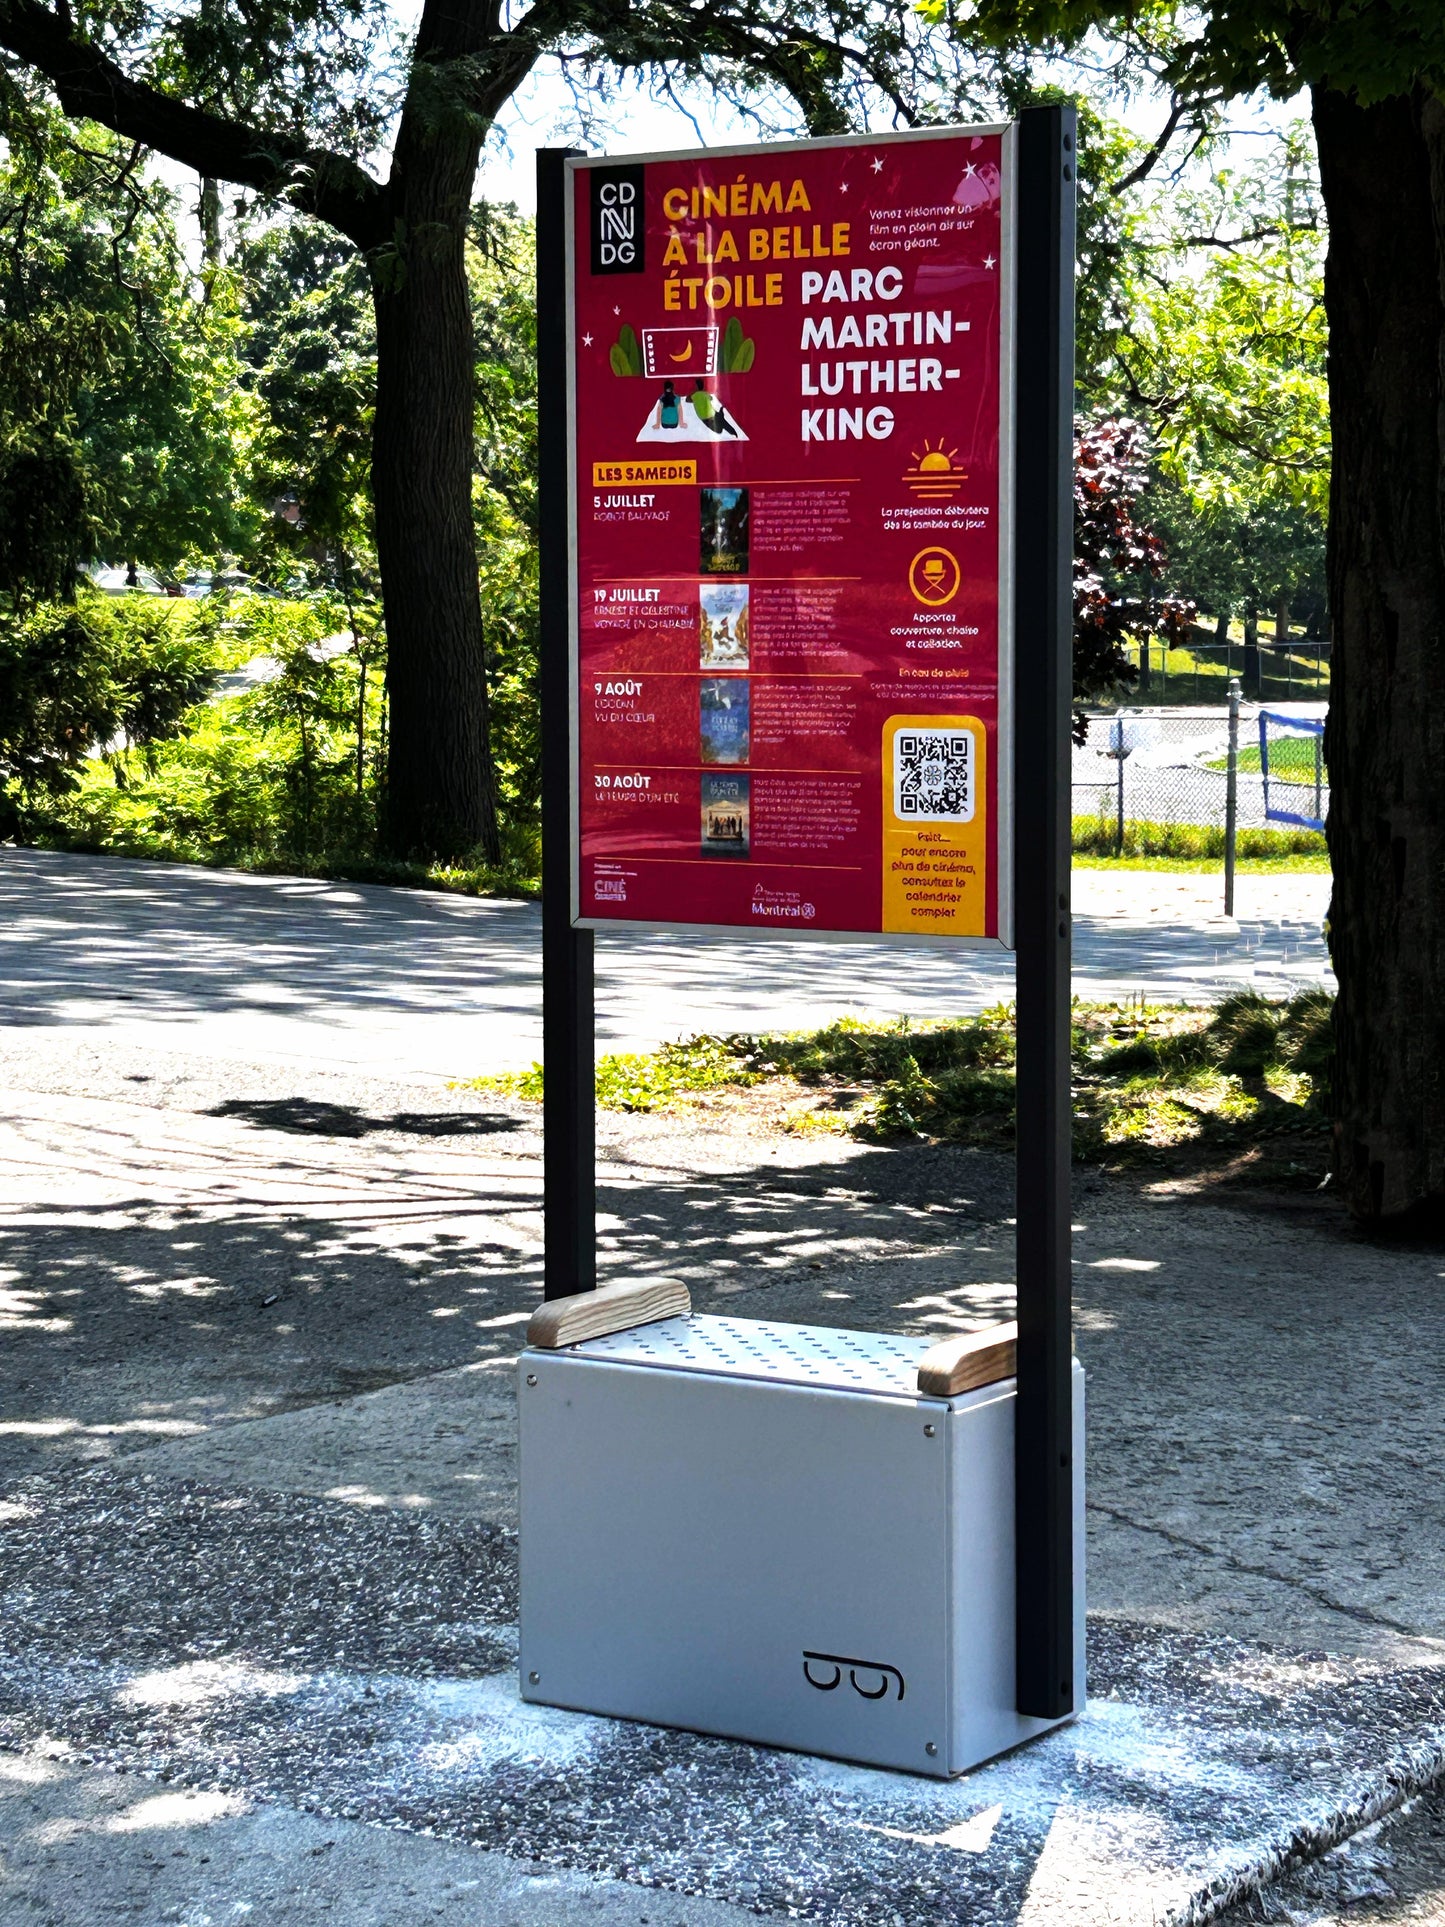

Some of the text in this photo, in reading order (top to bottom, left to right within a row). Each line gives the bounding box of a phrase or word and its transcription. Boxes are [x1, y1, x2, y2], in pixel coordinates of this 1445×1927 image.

[600, 182, 636, 206] CD
[663, 174, 811, 221] CINÉMA
[956, 219, 975, 230] sur
[600, 241, 636, 265] DG
[662, 222, 851, 266] À LA BELLE
[664, 269, 783, 311] ÉTOILE
[801, 265, 904, 305] PARC
[800, 310, 971, 350] MARTIN-
[801, 358, 961, 396] LUTHER-
[801, 405, 895, 442] KING
[598, 466, 692, 482] LES SAMEDIS
[593, 494, 656, 508] 5 JUILLET
[881, 507, 893, 517] La
[902, 519, 912, 529] la
[951, 519, 964, 529] du
[594, 588, 660, 602] 19 JUILLET
[594, 678, 643, 697] 9 AOÛT
[594, 771, 652, 789] 30 AOÛT
[751, 902, 801, 917] Montréal
